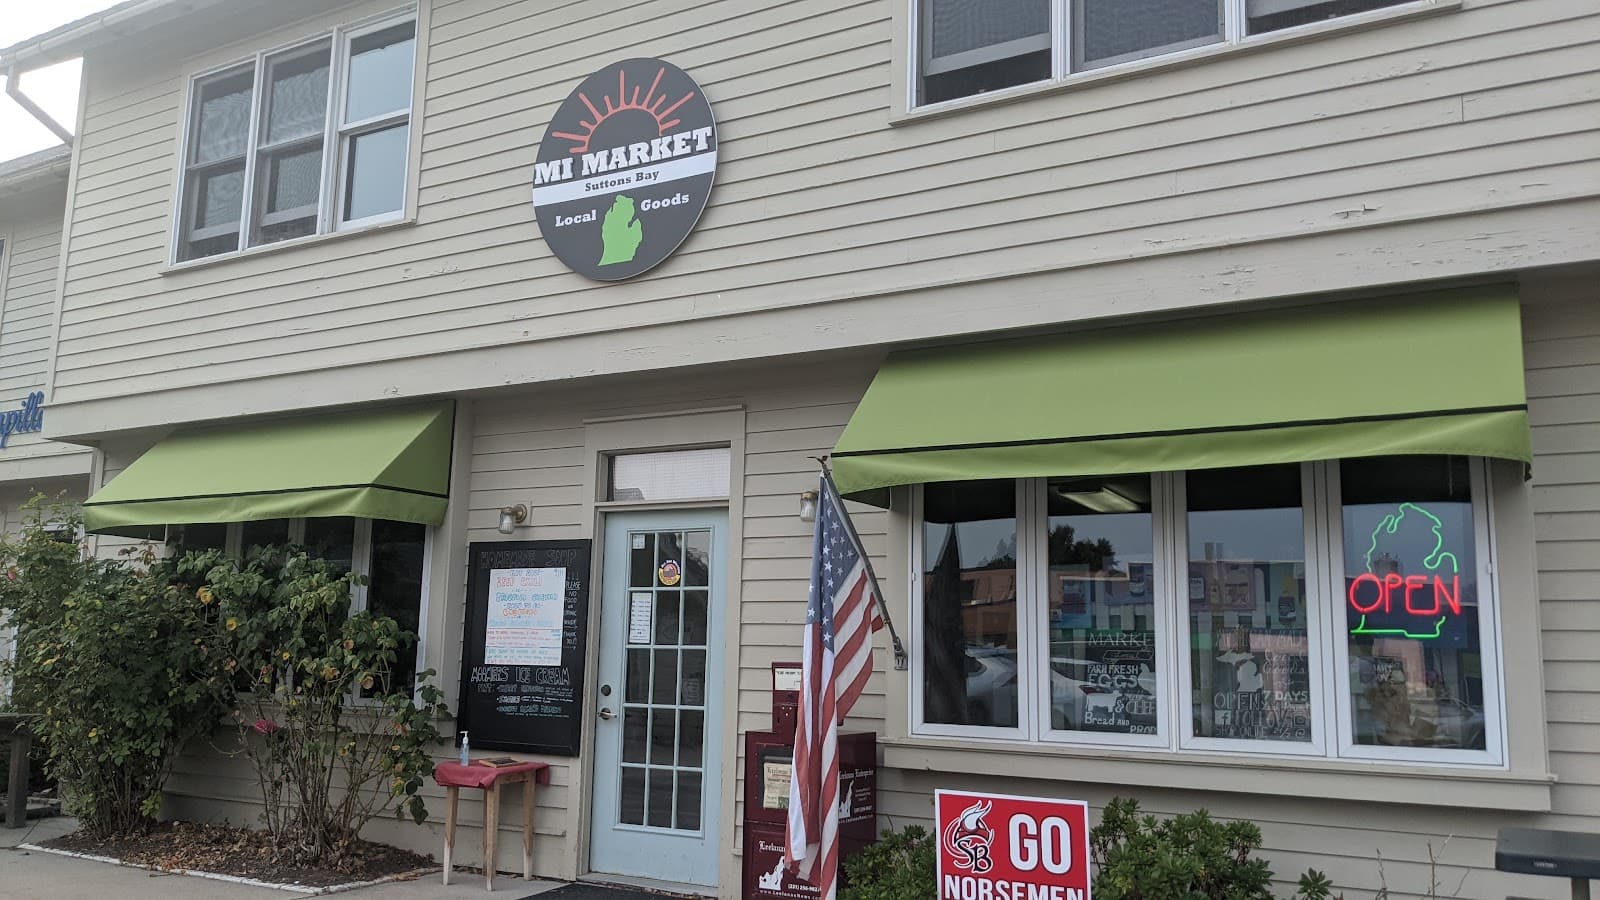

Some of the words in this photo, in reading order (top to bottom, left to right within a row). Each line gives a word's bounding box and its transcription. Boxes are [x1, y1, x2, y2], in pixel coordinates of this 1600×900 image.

[534, 157, 574, 185] MI
[581, 126, 713, 176] MARKET
[584, 174, 632, 192] Suttons
[635, 170, 660, 184] Bay
[640, 193, 690, 212] Goods
[555, 210, 597, 227] Local
[1350, 573, 1461, 615] OPEN
[515, 667, 531, 684] ICE
[535, 667, 570, 686] CREAM
[1087, 664, 1107, 674] FARM
[1108, 664, 1138, 675] FRESH
[1088, 673, 1138, 688] EGGS
[1275, 691, 1308, 702] DAYS
[1085, 712, 1114, 725] Bread
[1008, 813, 1072, 875] GO
[944, 874, 1083, 900] NORSEMEN
